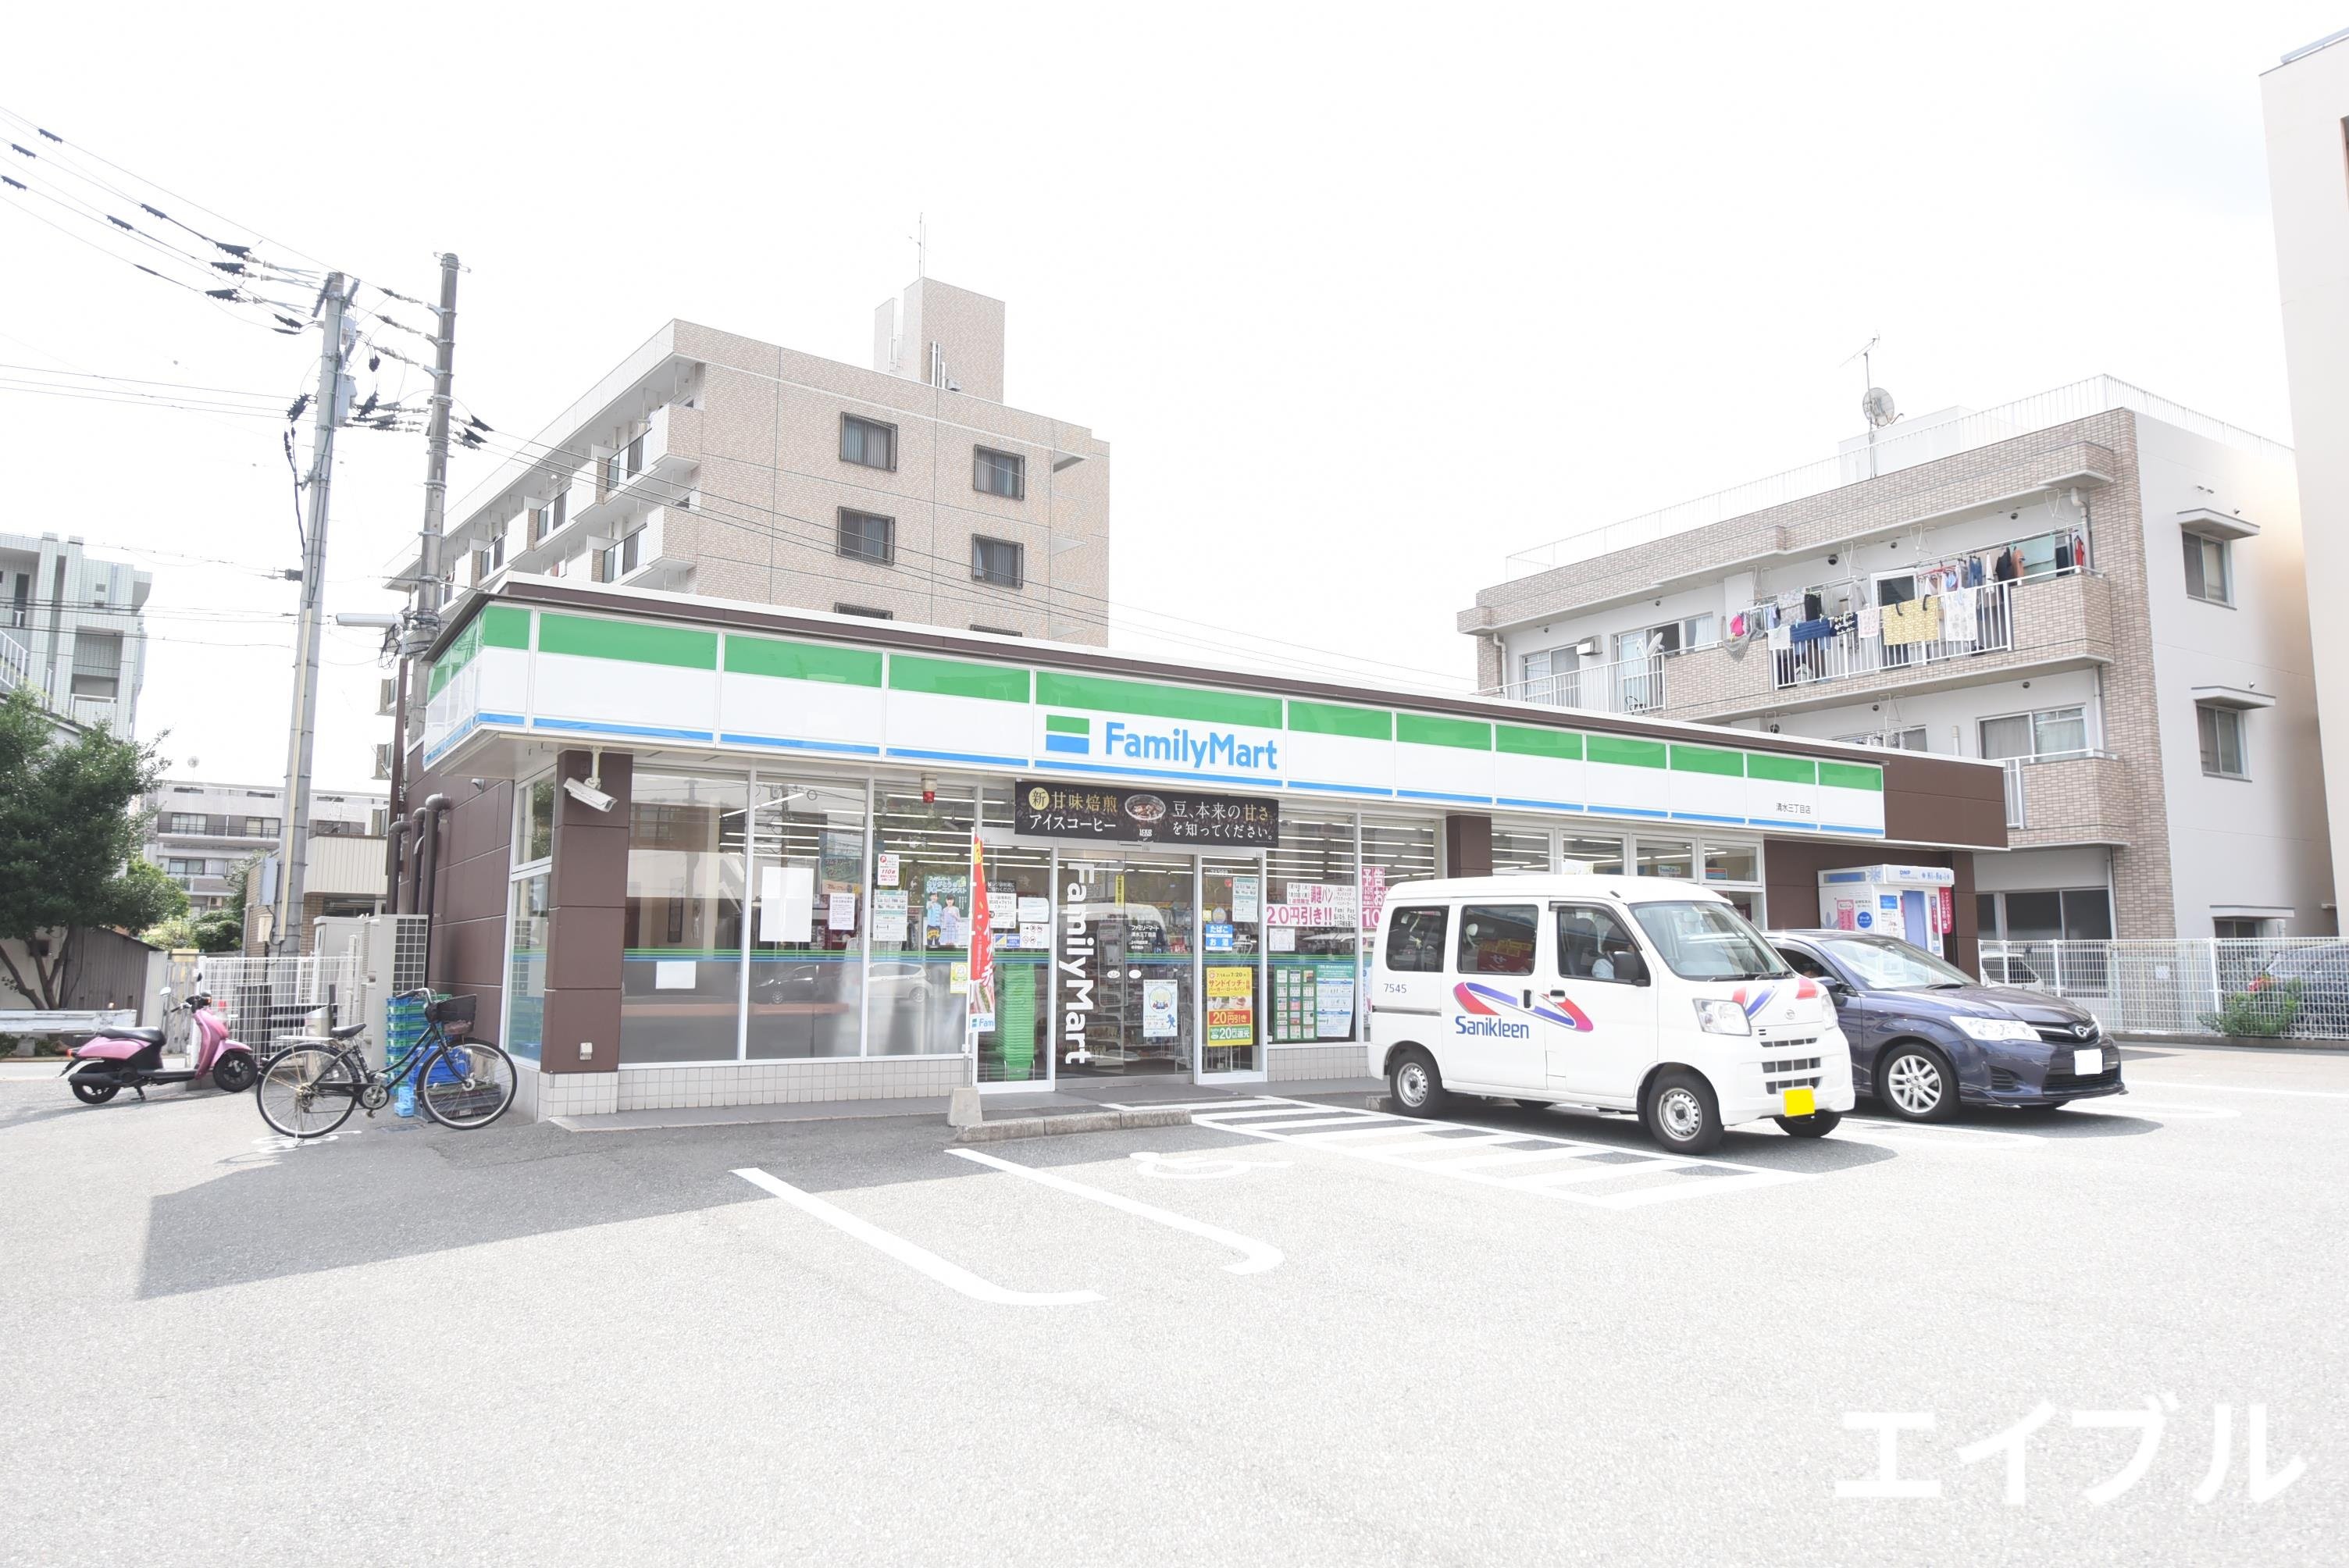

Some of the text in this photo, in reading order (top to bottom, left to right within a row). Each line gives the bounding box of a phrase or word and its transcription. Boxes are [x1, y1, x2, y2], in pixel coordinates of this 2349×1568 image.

[1106, 722, 1277, 770] FamilyMart
[1171, 800, 1269, 822] 豆、本来の甘さ
[1776, 803, 1811, 814] 清水三丁目店
[1029, 814, 1117, 832] アイスコーヒー
[1172, 821, 1273, 840] を知ってください。
[1058, 862, 1095, 1064] FamilyMart
[1384, 983, 1407, 993] 7545
[1213, 1011, 1247, 1025] 20円引き
[1455, 1015, 1530, 1039] Sanikleen
